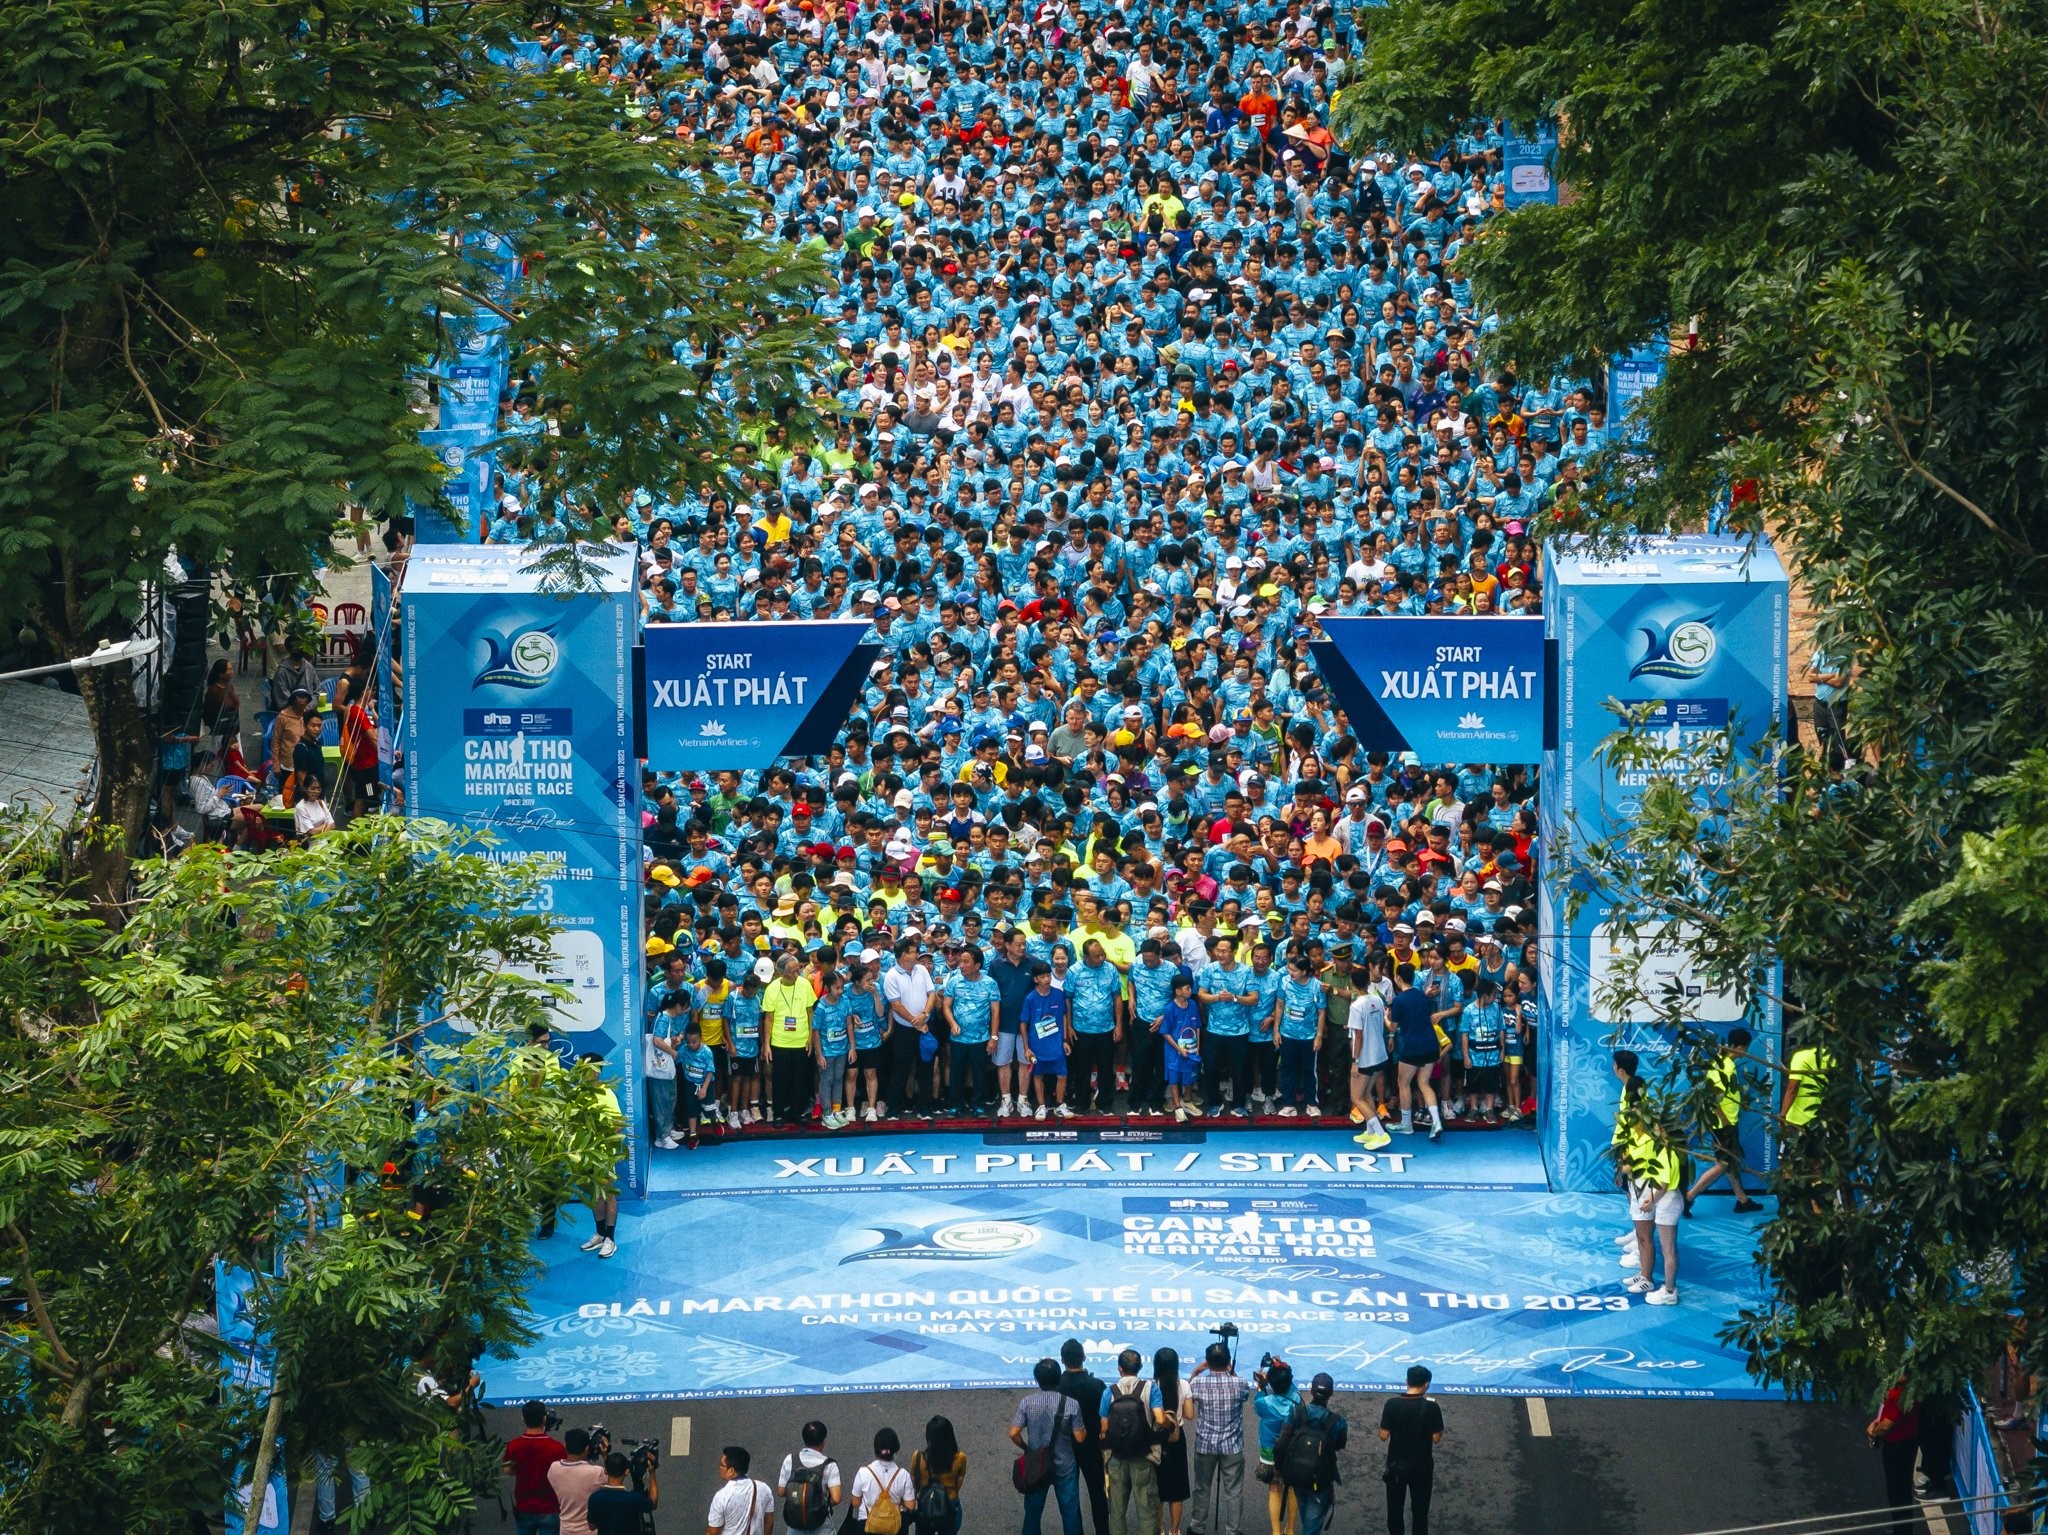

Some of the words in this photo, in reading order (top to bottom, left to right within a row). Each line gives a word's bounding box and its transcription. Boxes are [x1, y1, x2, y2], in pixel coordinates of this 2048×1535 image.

[1520, 145, 1542, 154] 2023
[450, 496, 469, 505] THO
[706, 653, 752, 670] START
[1436, 646, 1482, 662] START
[652, 671, 728, 708] XUẤT
[734, 671, 808, 706] PHÁT
[1381, 663, 1458, 699] XUẤT
[1462, 665, 1536, 699] PHÁT
[465, 740, 508, 760] CAN
[529, 740, 572, 760] THO
[465, 763, 573, 780] MARATHON
[465, 782, 533, 795] HERITAGE
[537, 782, 573, 795] RACE
[619, 842, 627, 876] MARATHON
[622, 974, 631, 1008] MARATHON
[774, 1150, 958, 1179] XUẤT
[975, 1149, 1153, 1173] PHÁT
[1174, 1152, 1200, 1172] /
[1219, 1152, 1414, 1173] START
[1123, 1216, 1223, 1231] CAN
[1270, 1217, 1372, 1233] THO
[1123, 1232, 1375, 1246] MARATHON
[1124, 1245, 1281, 1256] HERITAGE
[1293, 1247, 1377, 1258] RACE
[578, 1298, 670, 1318] GIẢI
[682, 1291, 935, 1315] MARATHON
[949, 1285, 1071, 1303] QUỐC
[1084, 1284, 1140, 1302] TẾ
[1152, 1288, 1192, 1302] DI
[1205, 1286, 1298, 1305] SẢN
[1312, 1287, 1408, 1306] CẦN
[1421, 1291, 1510, 1310] THƠ
[1523, 1296, 1630, 1311] 2023
[801, 1314, 858, 1325] CAN
[870, 1311, 922, 1323] THO
[930, 1307, 1088, 1320] MARATHON
[1118, 1307, 1256, 1320] HERITAGE
[1261, 1309, 1334, 1320] RACE
[1343, 1310, 1410, 1323] 2023
[919, 1320, 1000, 1334] NGÀY
[1000, 1322, 1014, 1332] 3
[1022, 1319, 1116, 1332] THÁNG
[1123, 1320, 1150, 1331] 12
[1156, 1319, 1220, 1332] NĂM
[1284, 1340, 1538, 1373] Heritage
[1529, 1346, 1704, 1373] Race
